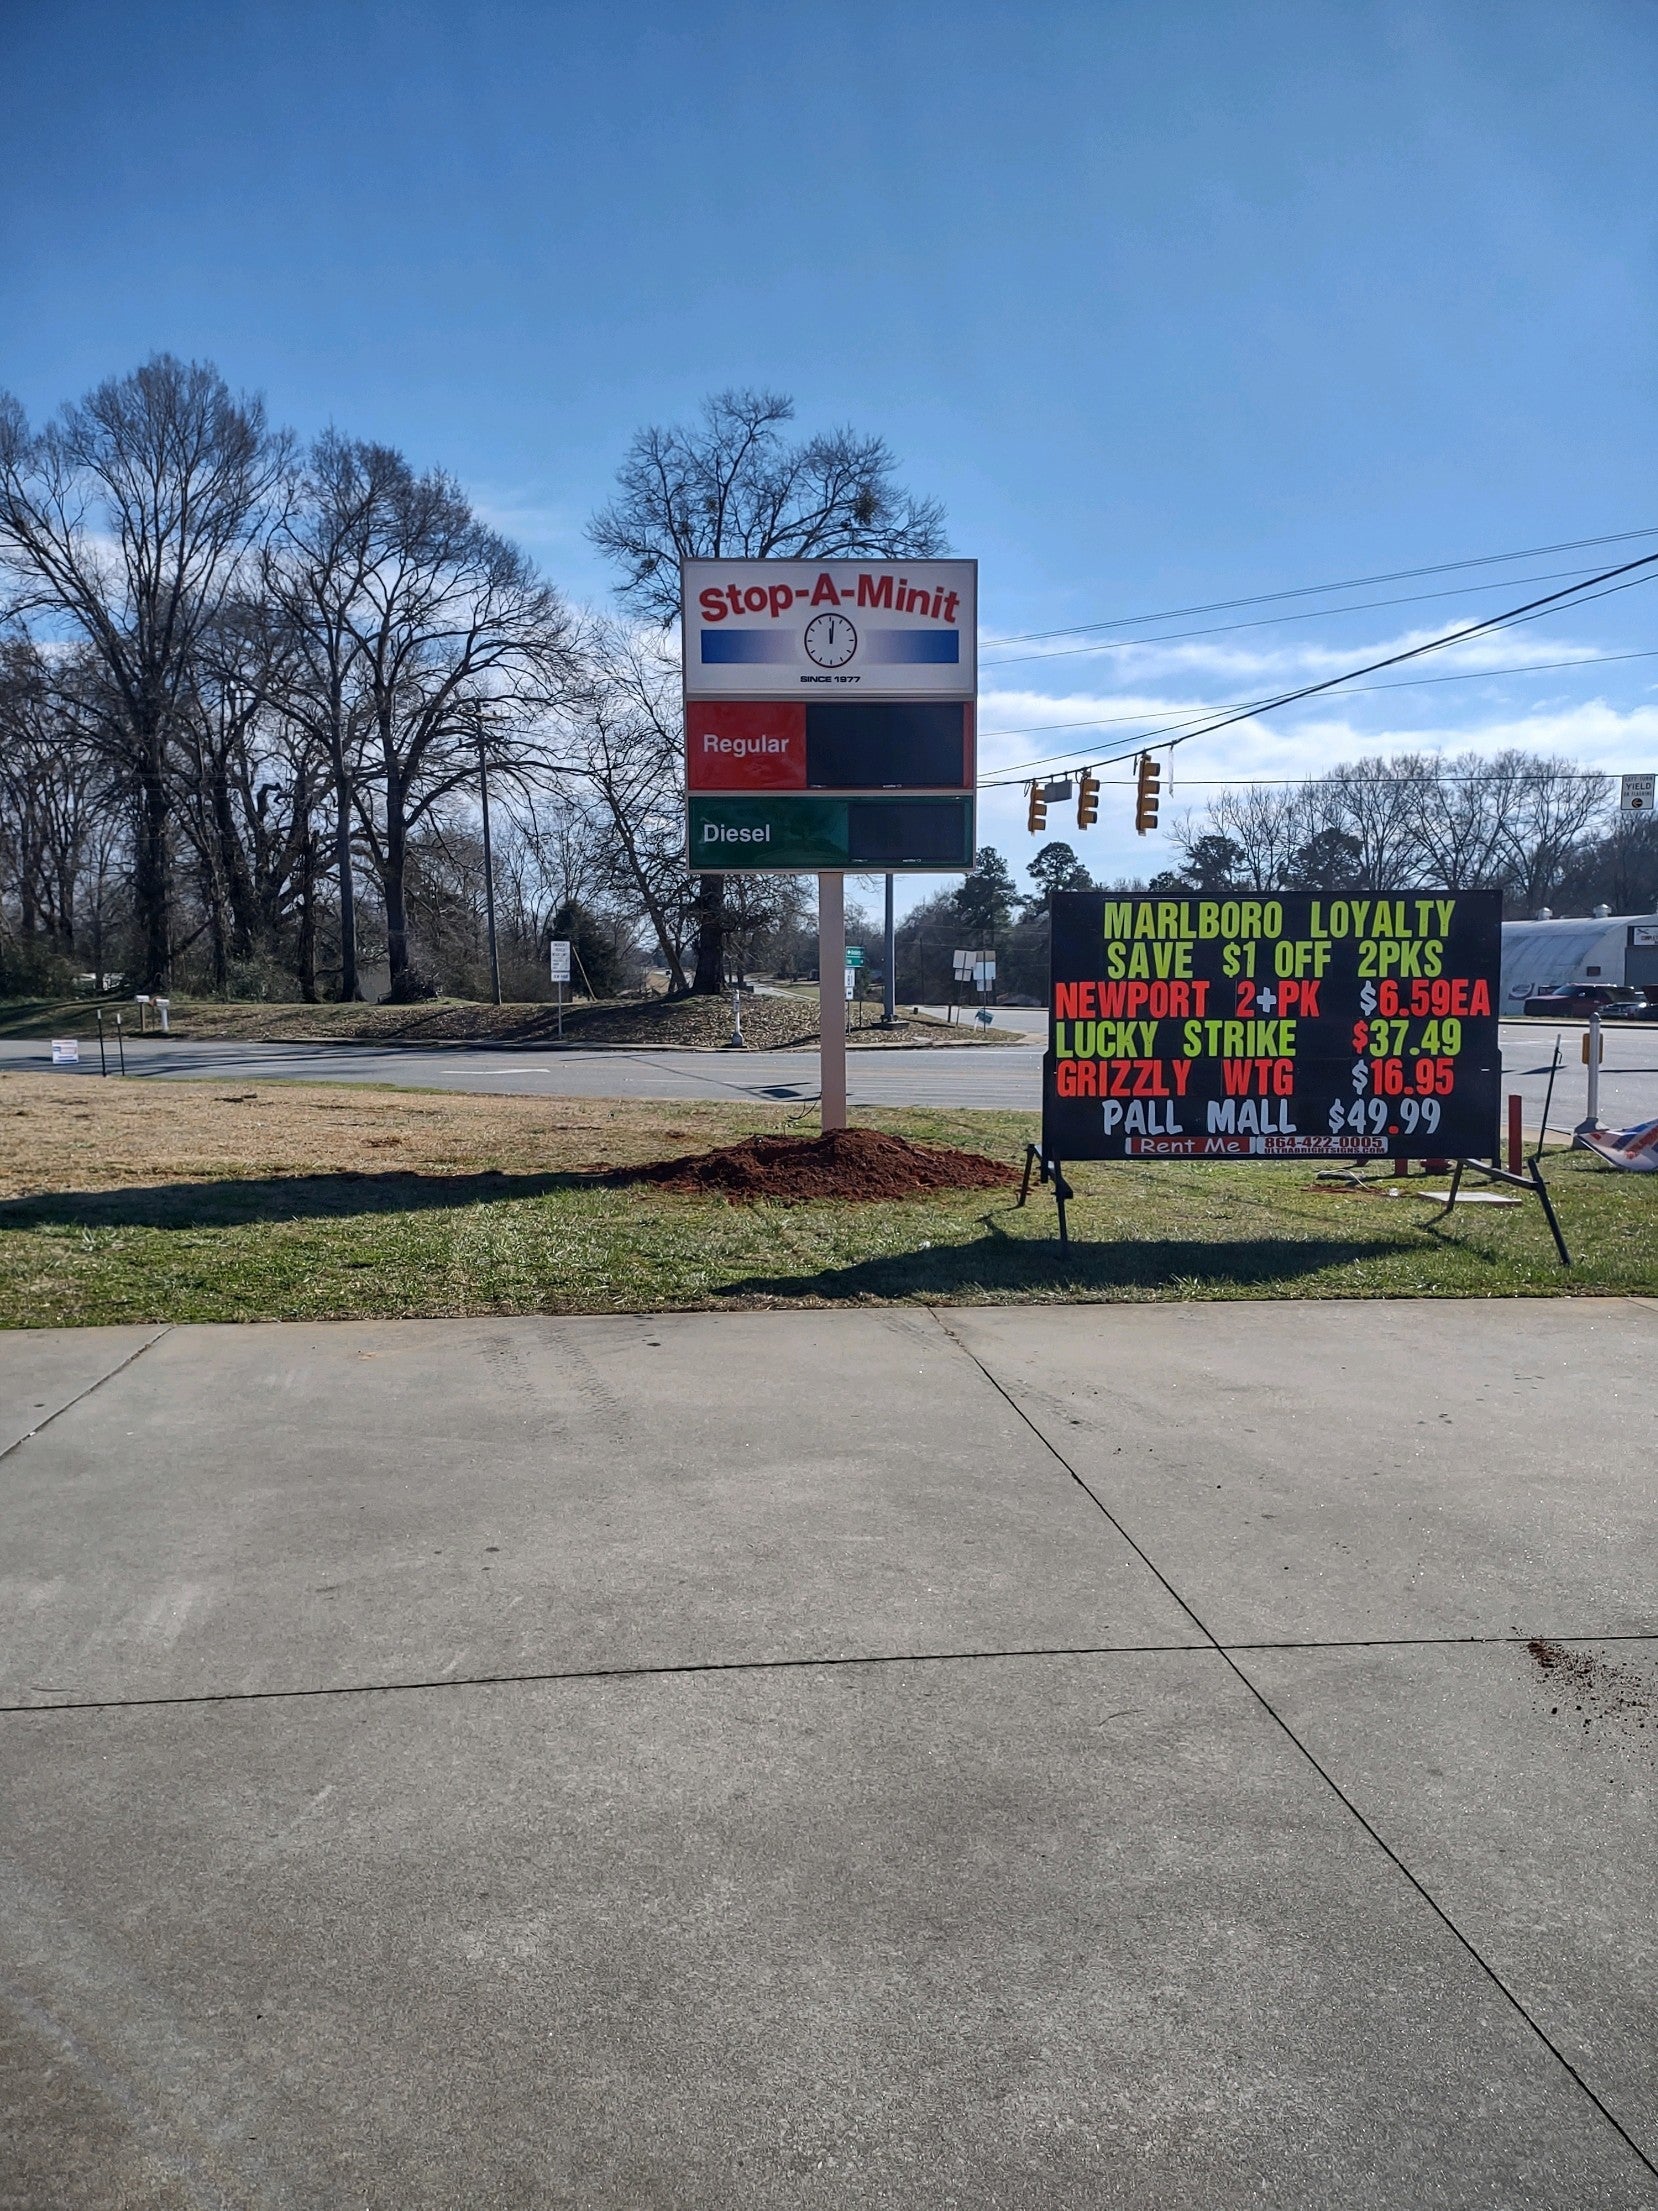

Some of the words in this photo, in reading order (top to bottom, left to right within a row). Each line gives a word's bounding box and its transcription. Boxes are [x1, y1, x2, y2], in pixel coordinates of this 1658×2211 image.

[699, 573, 960, 623] Stop-A-Minit
[703, 734, 789, 758] Regular
[704, 824, 770, 842] Diesel
[1104, 901, 1283, 940] MARLBORO
[1311, 900, 1456, 938] LOYALTY
[1107, 942, 1194, 979] SAVE
[1223, 942, 1256, 978] $1
[1274, 941, 1332, 978] OFF
[1357, 940, 1444, 978] 2PKS
[1055, 981, 1211, 1020] NEWPORT
[1236, 981, 1321, 1018] 2+PK
[1360, 979, 1491, 1017] $6.59EA
[1056, 1021, 1159, 1058] LUCKY
[1183, 1020, 1297, 1057] STRIKE
[1352, 1018, 1462, 1056] $37.49
[1056, 1060, 1193, 1097] GRIZZLY
[1223, 1059, 1294, 1095] WTG
[1352, 1058, 1455, 1096] $16.95
[1102, 1100, 1184, 1135] PALL
[1207, 1099, 1297, 1134] MALL
[1328, 1098, 1441, 1135] $49.99
[1140, 1138, 1195, 1153] Rent
[1204, 1138, 1241, 1152] Me
[1264, 1136, 1383, 1148] 864-422-0005
